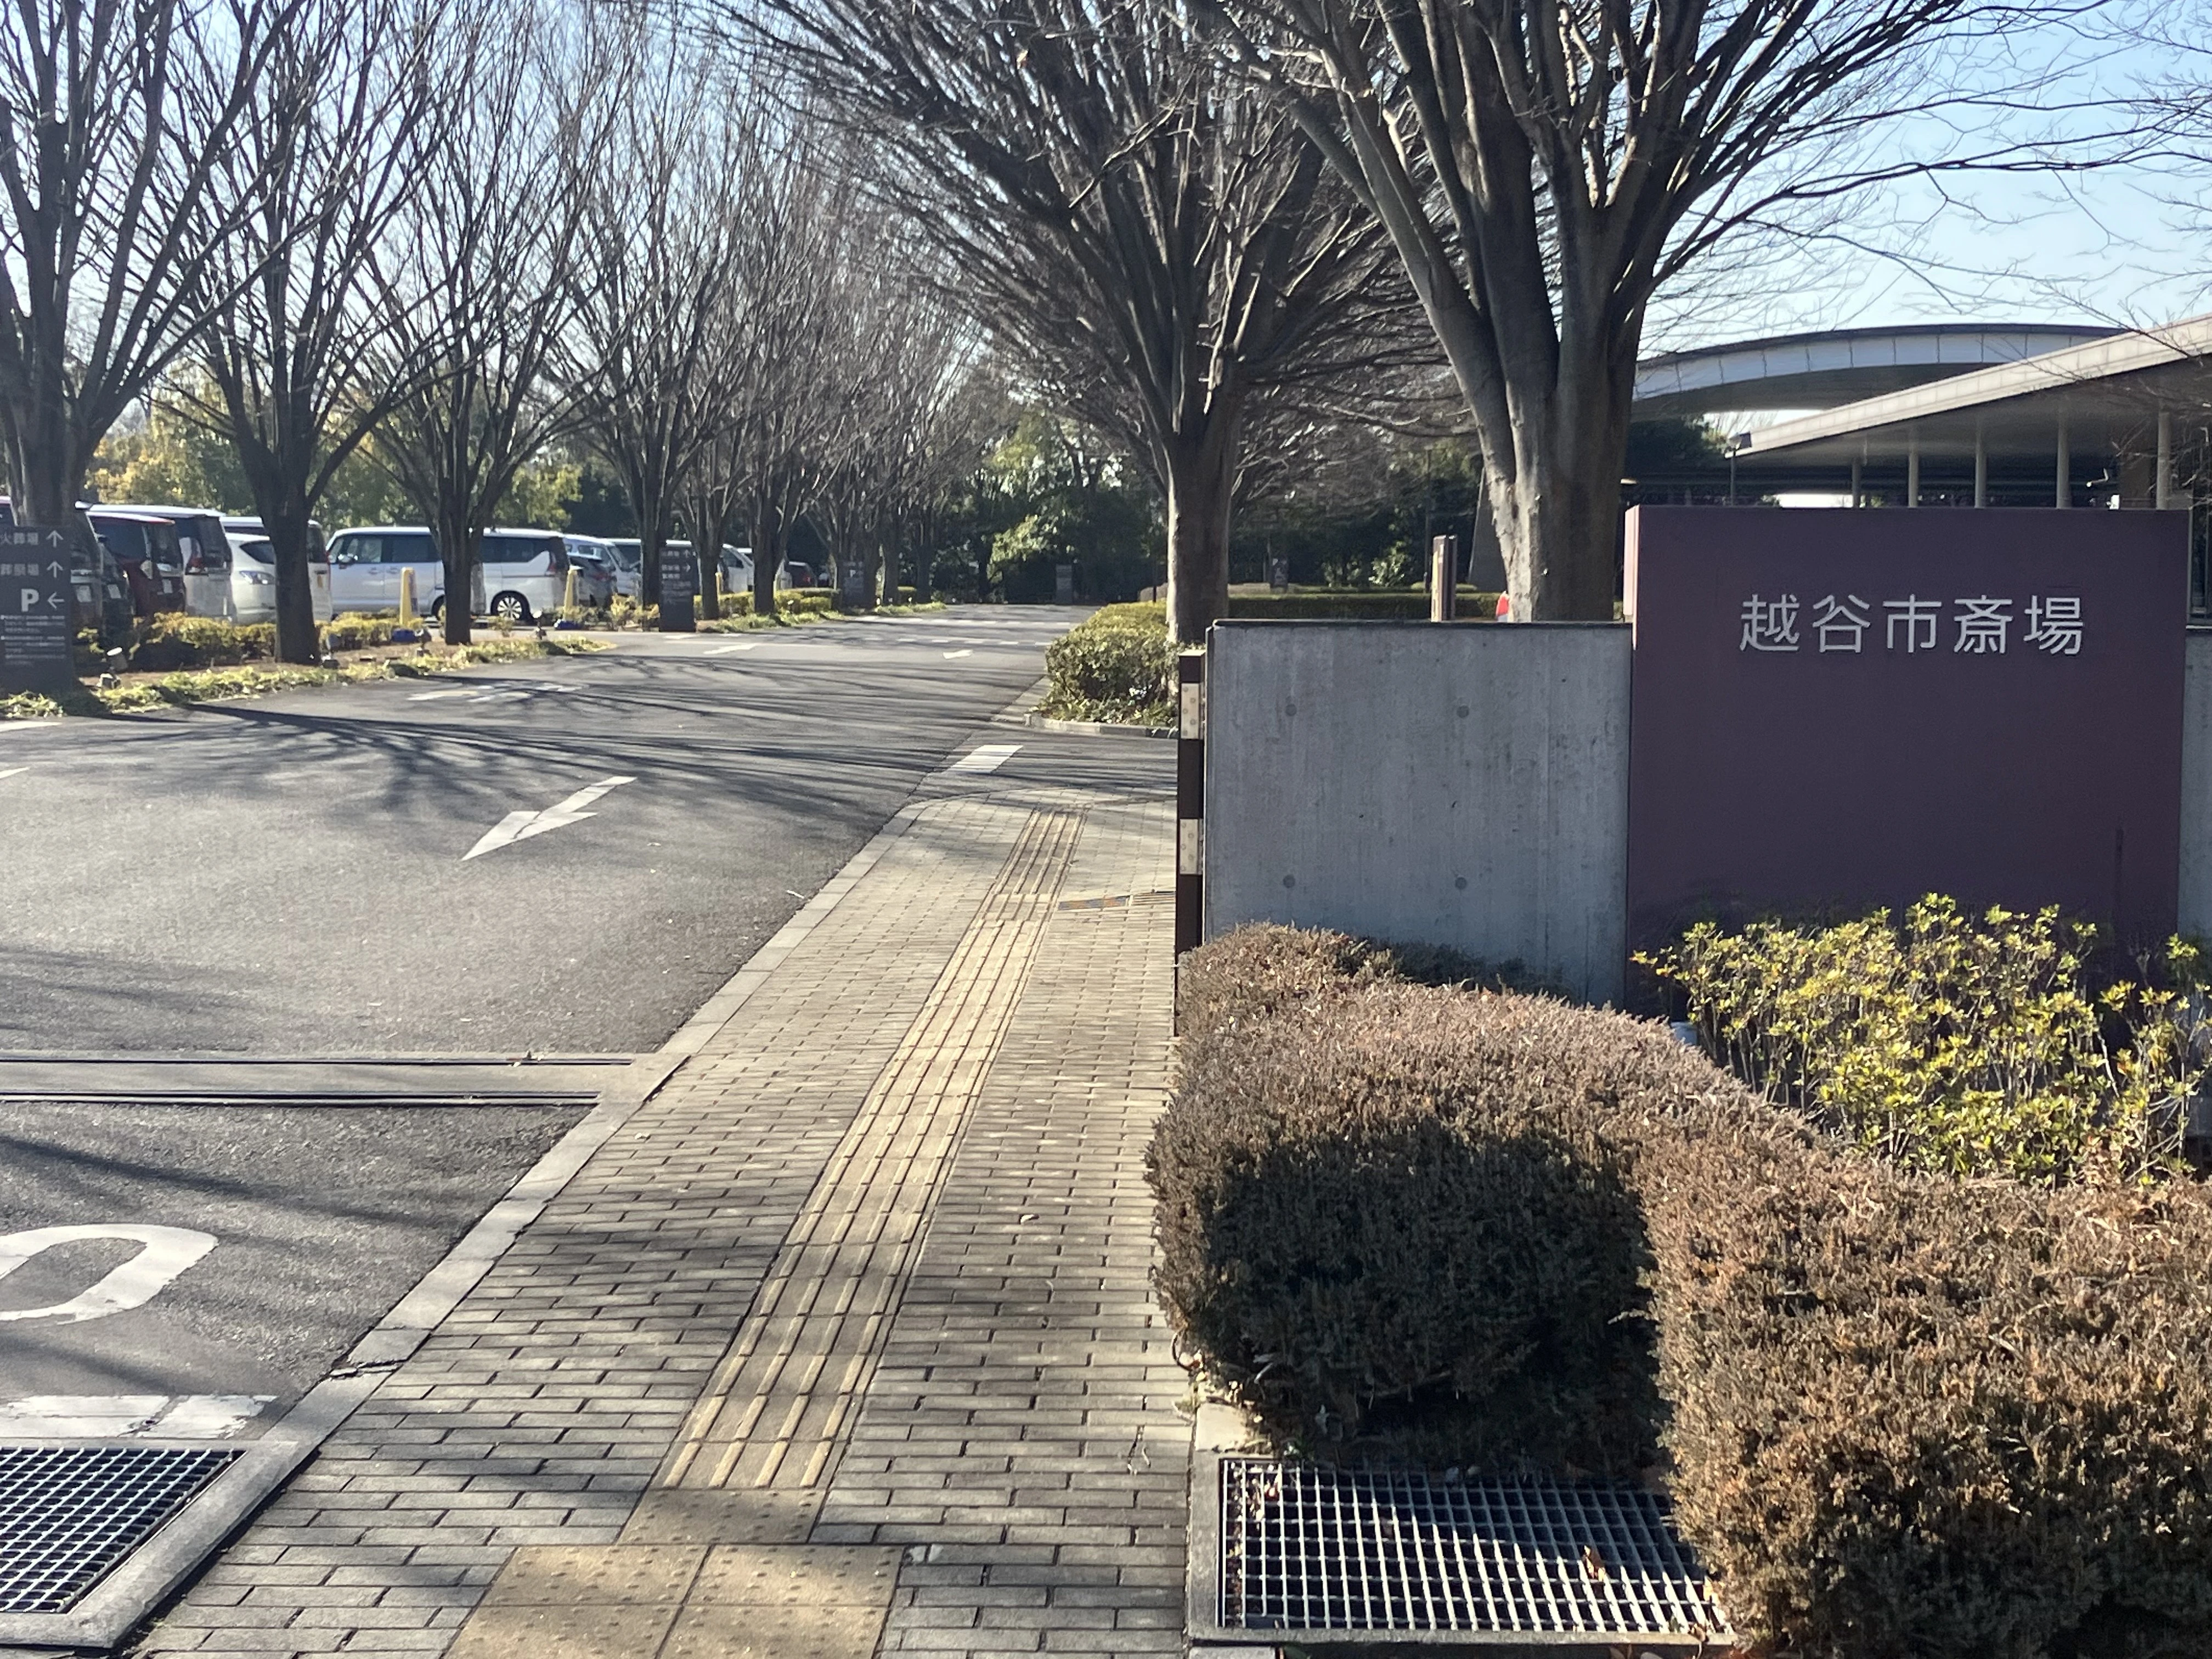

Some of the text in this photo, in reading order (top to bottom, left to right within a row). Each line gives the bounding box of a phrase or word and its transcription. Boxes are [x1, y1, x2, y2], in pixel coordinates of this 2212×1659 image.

[21, 588, 40, 612] P
[1739, 594, 2084, 656] 越谷市斎場
